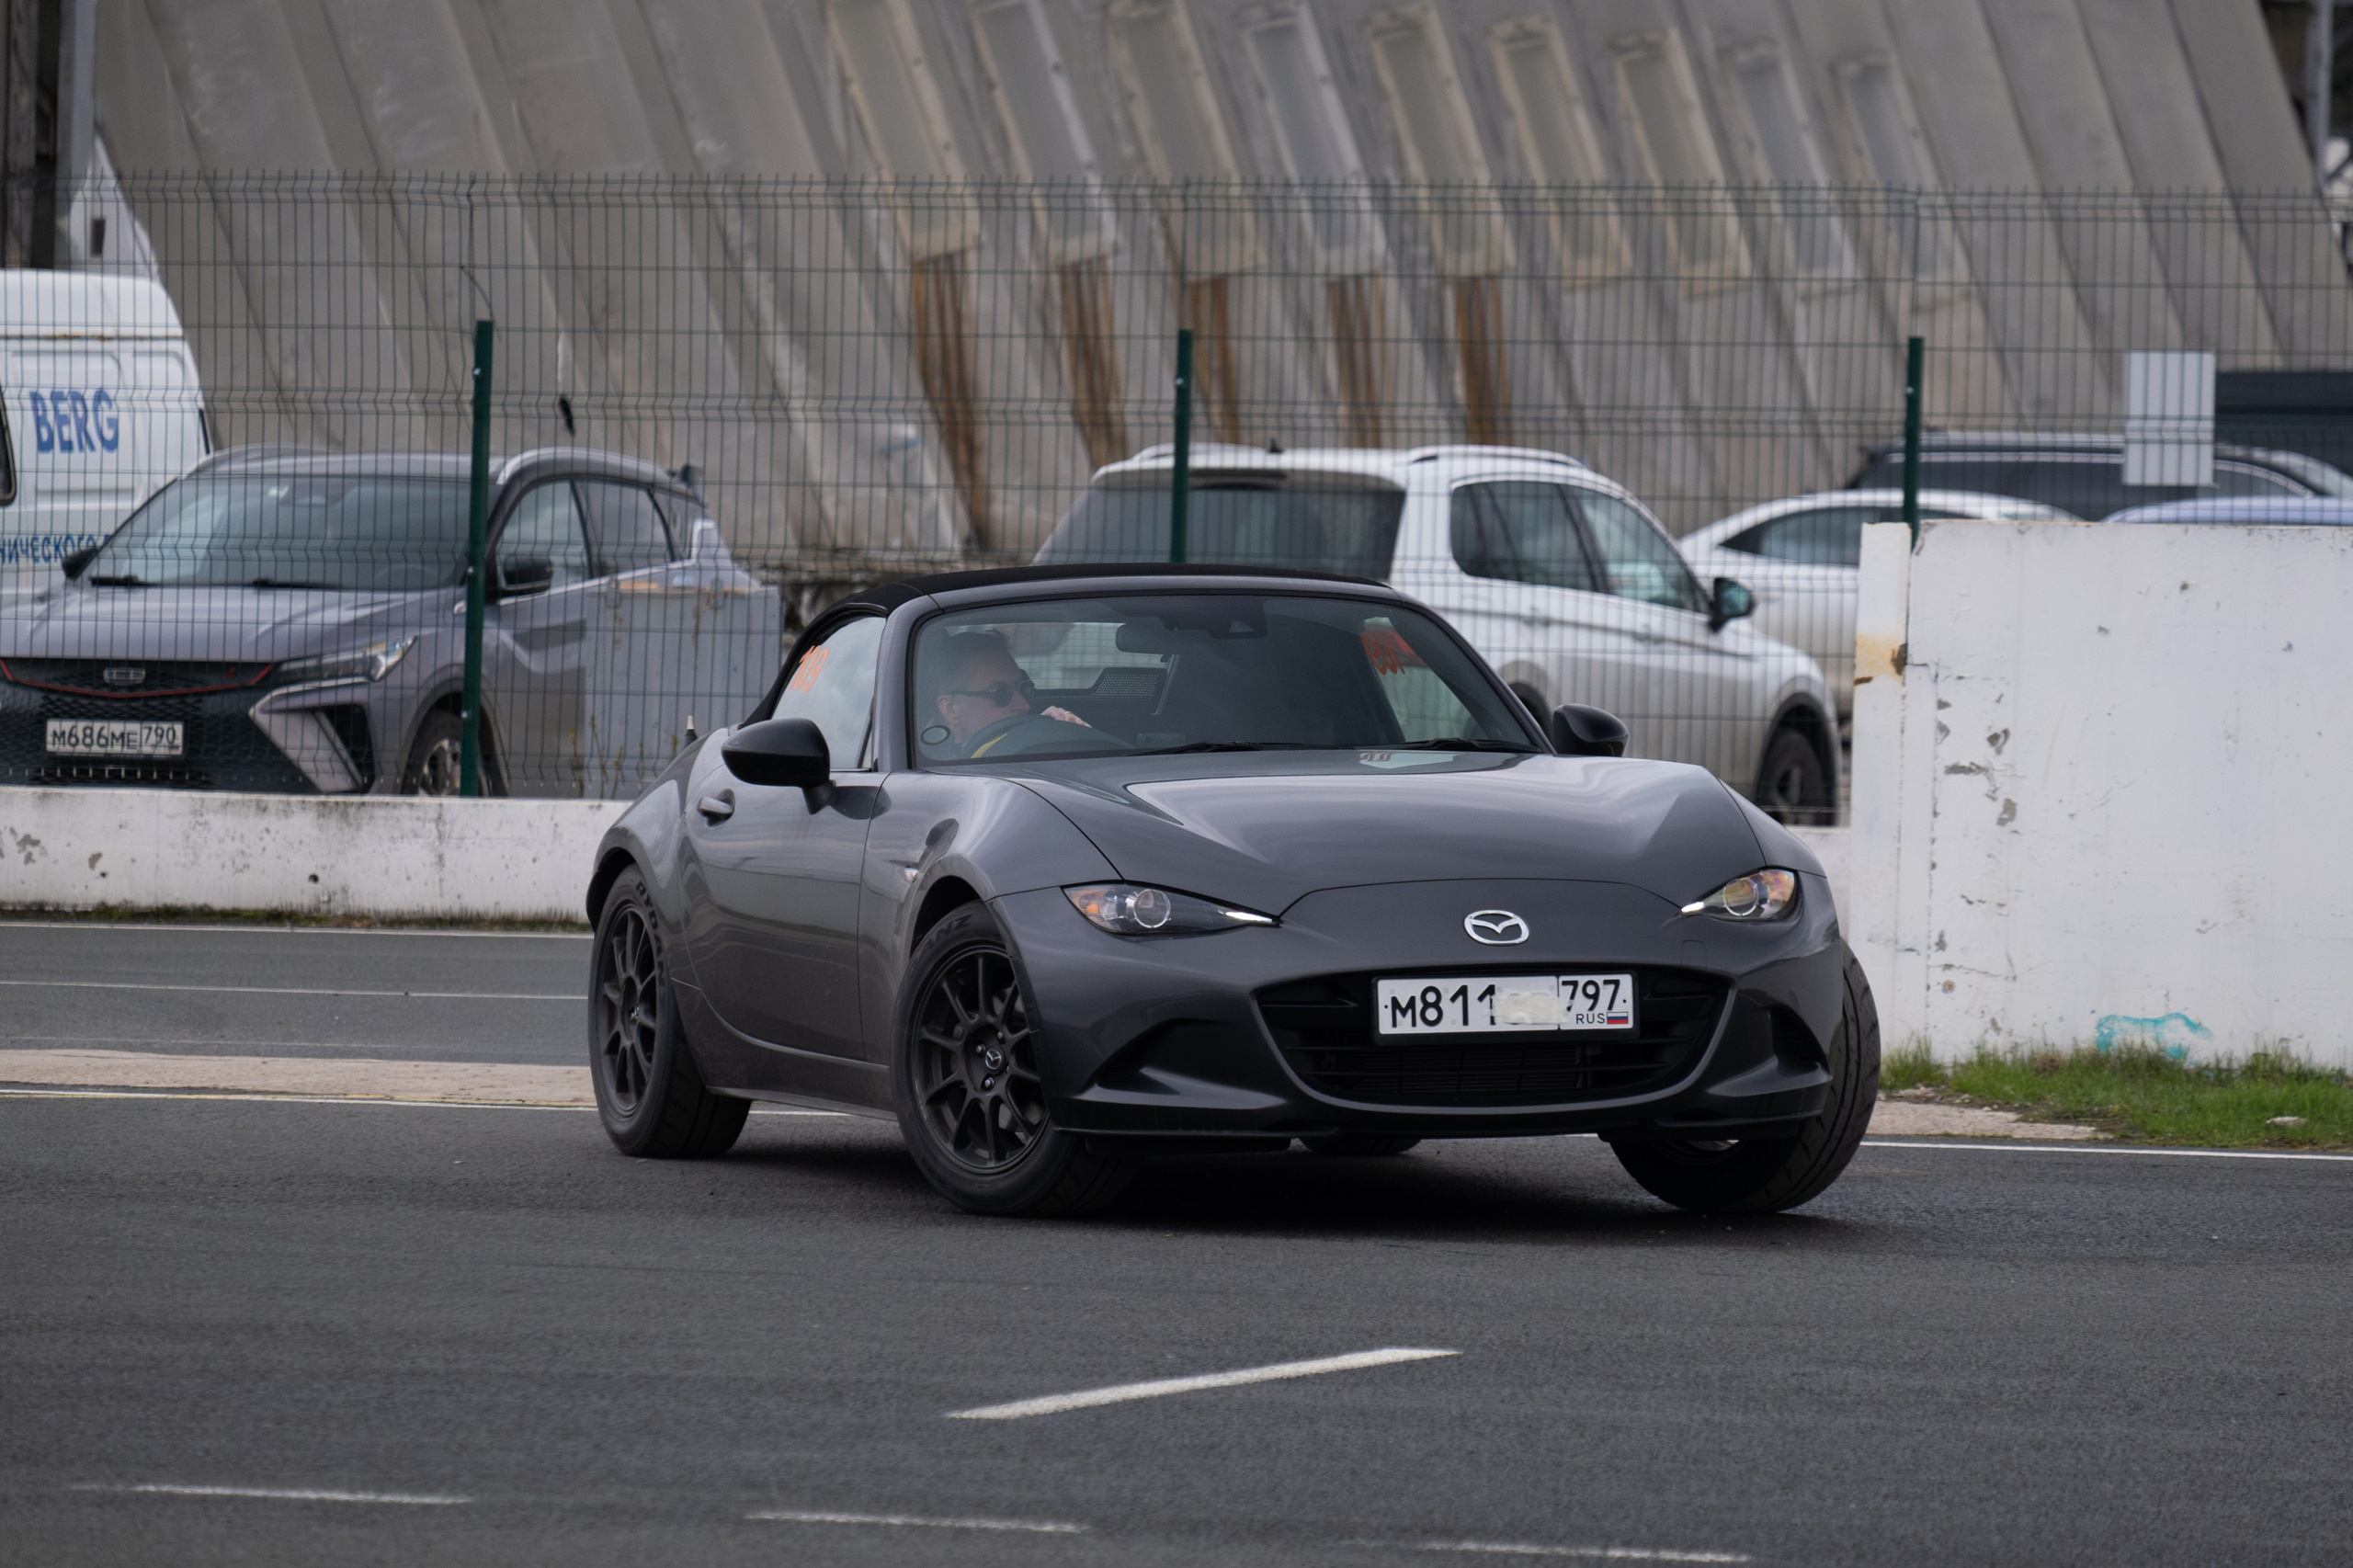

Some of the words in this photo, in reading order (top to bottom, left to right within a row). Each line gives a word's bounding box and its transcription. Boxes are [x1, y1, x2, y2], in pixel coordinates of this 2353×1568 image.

[29, 389, 119, 453] BERG
[51, 724, 139, 749] M686ME
[143, 725, 176, 745] 790
[1391, 983, 1548, 1028] M811
[1561, 979, 1620, 1012] 797
[1575, 1013, 1606, 1025] RUS
